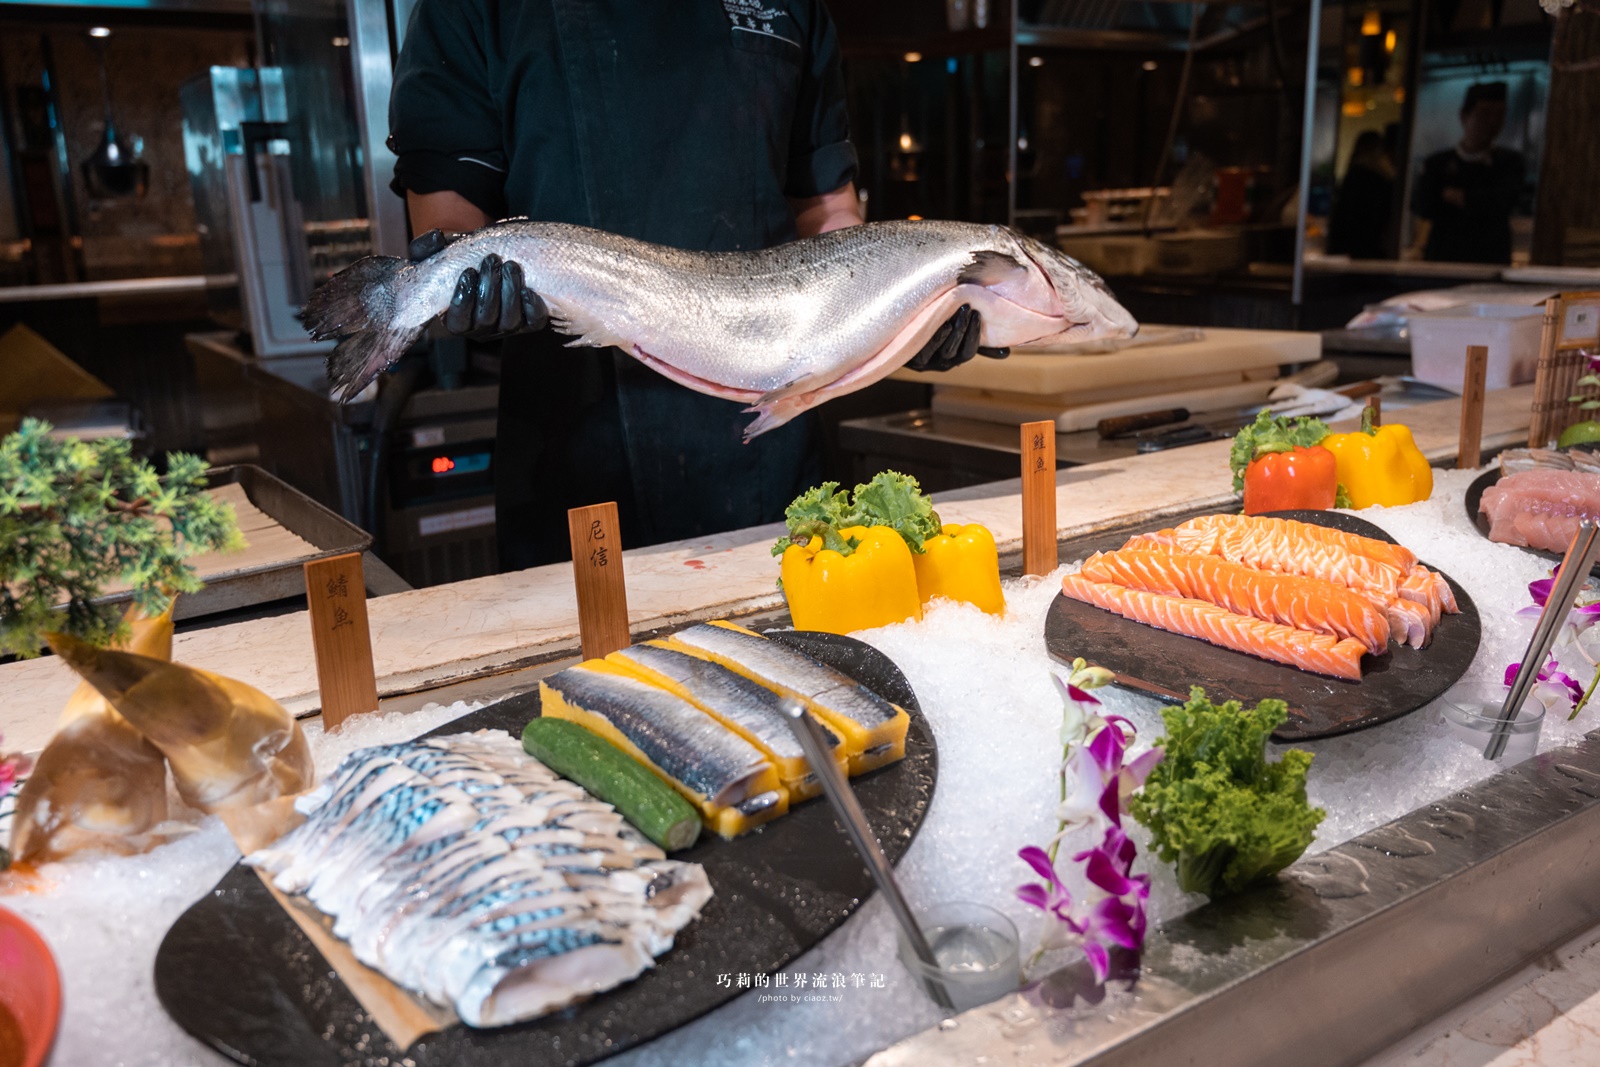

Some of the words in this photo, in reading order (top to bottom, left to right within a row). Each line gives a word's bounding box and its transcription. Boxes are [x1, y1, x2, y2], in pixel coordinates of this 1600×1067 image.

[1033, 433, 1047, 474] 鮭魚
[588, 519, 608, 568] 尼信
[326, 574, 353, 631] 鯖魚
